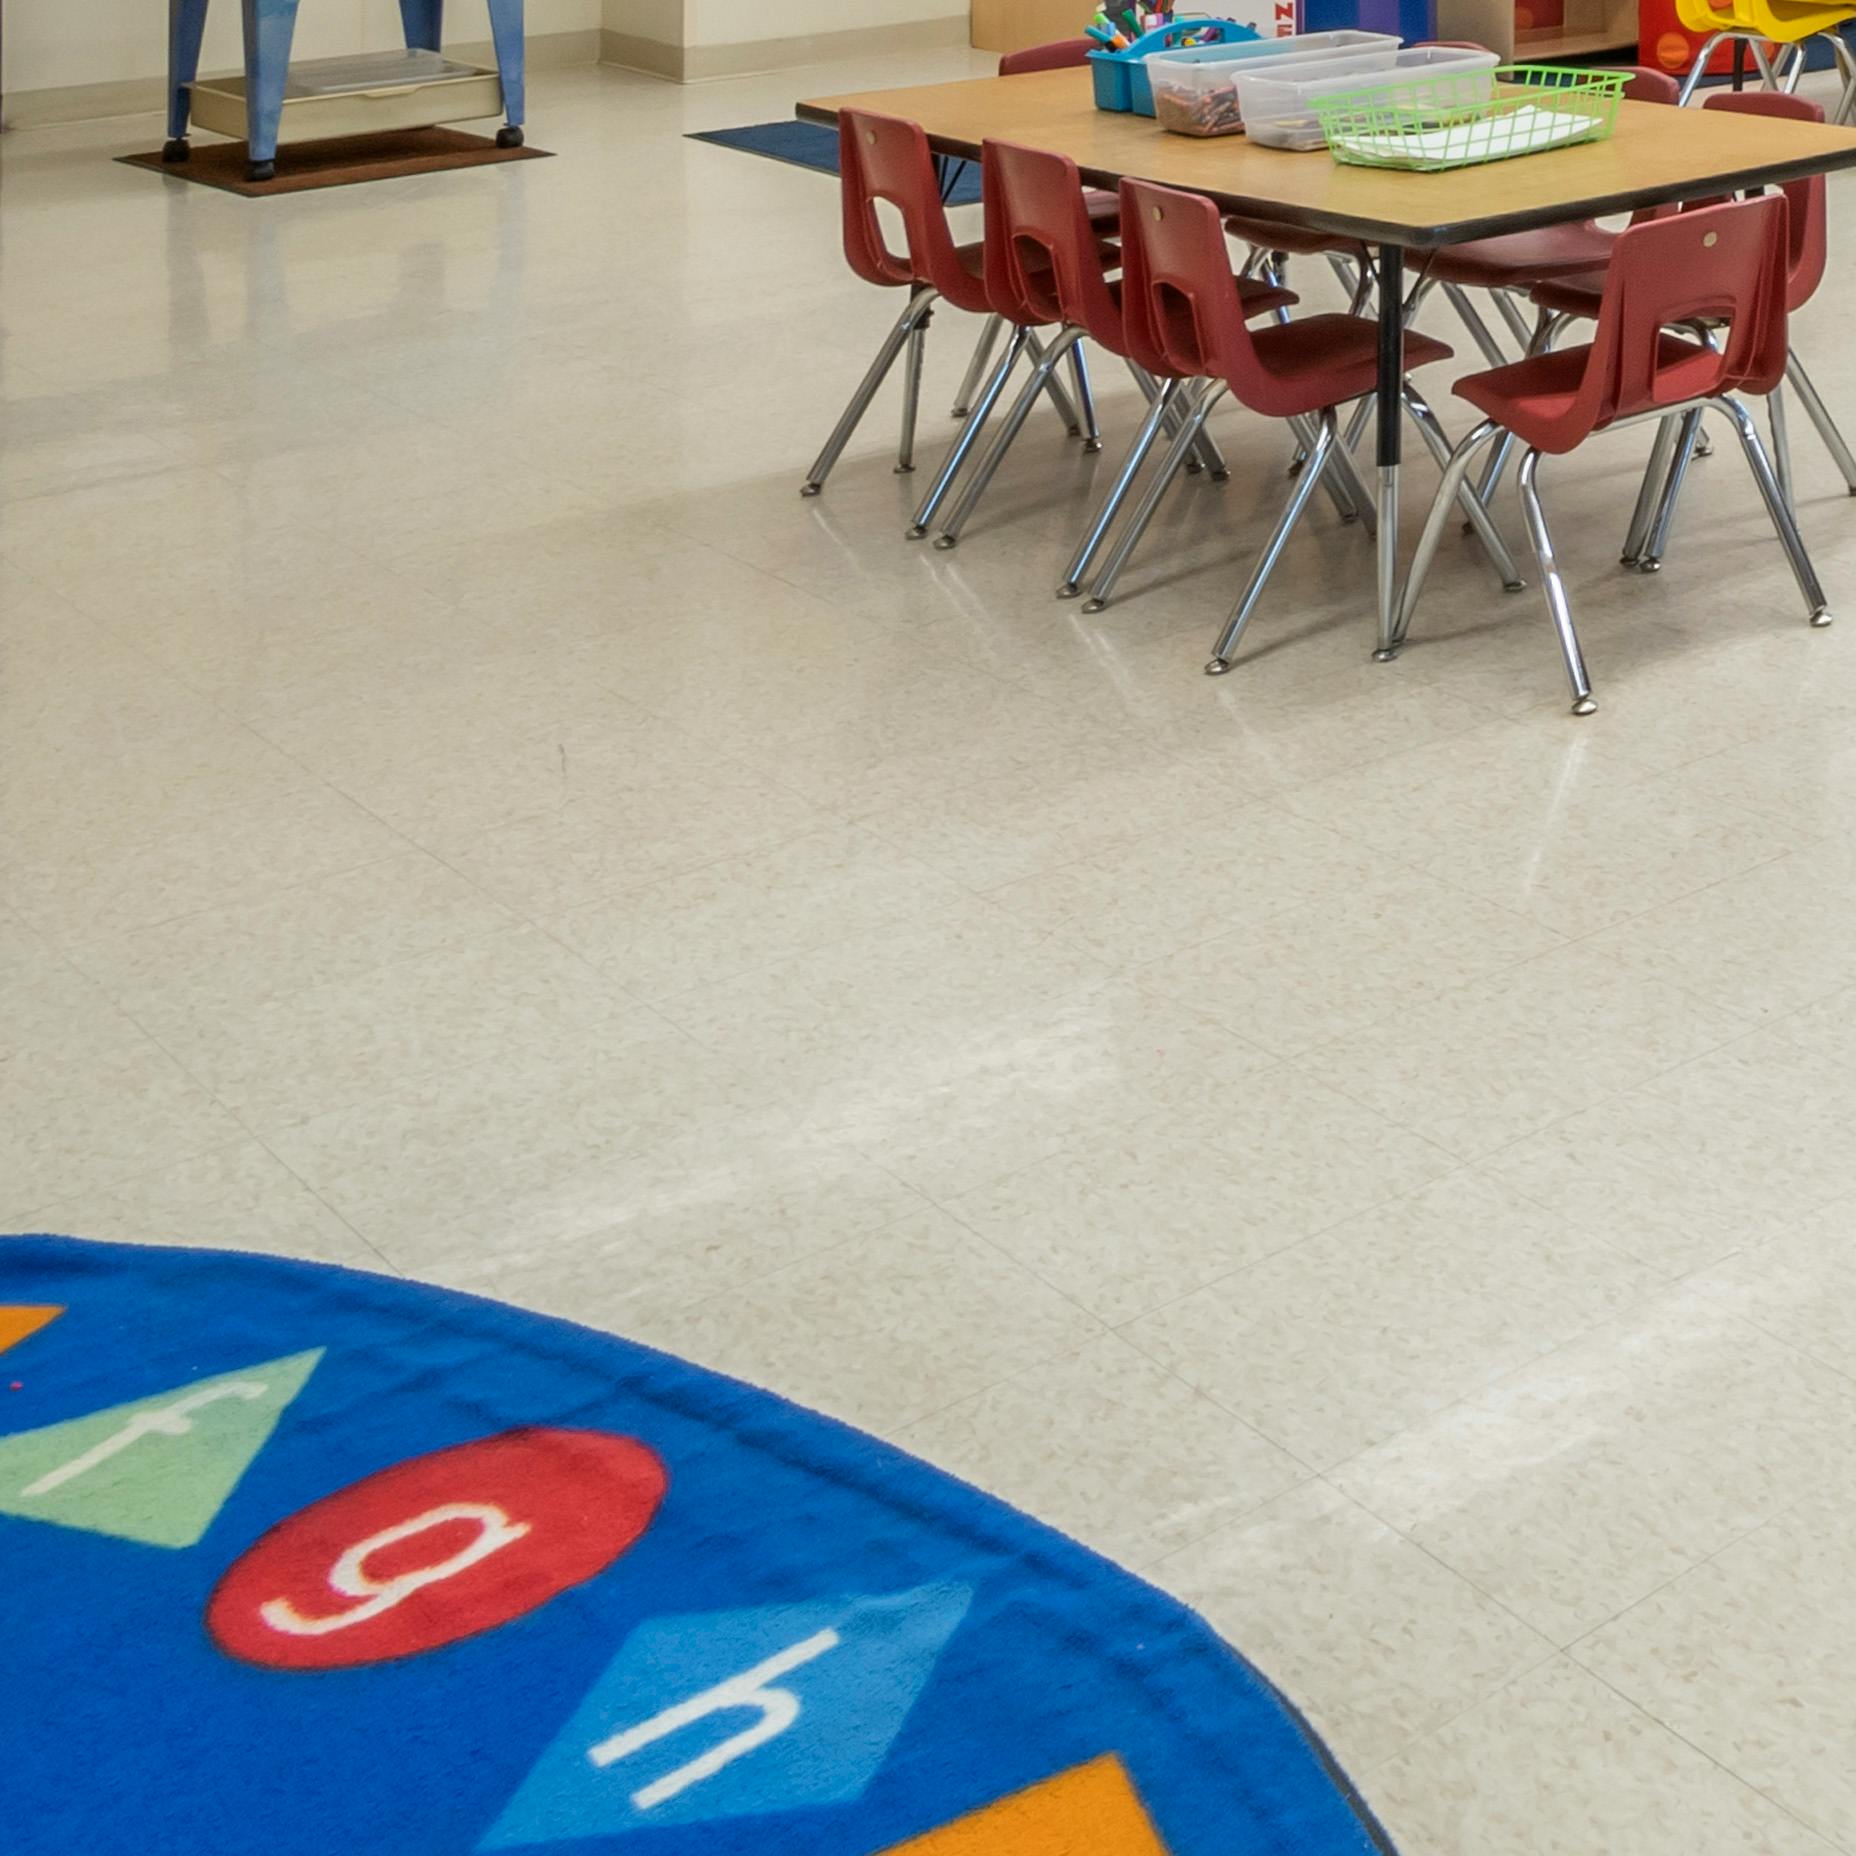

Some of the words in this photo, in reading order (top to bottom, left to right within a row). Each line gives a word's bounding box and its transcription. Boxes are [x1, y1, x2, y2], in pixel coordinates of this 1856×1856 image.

[19, 1379, 270, 1499] f
[258, 1500, 534, 1637] g
[586, 1626, 842, 1812] h
